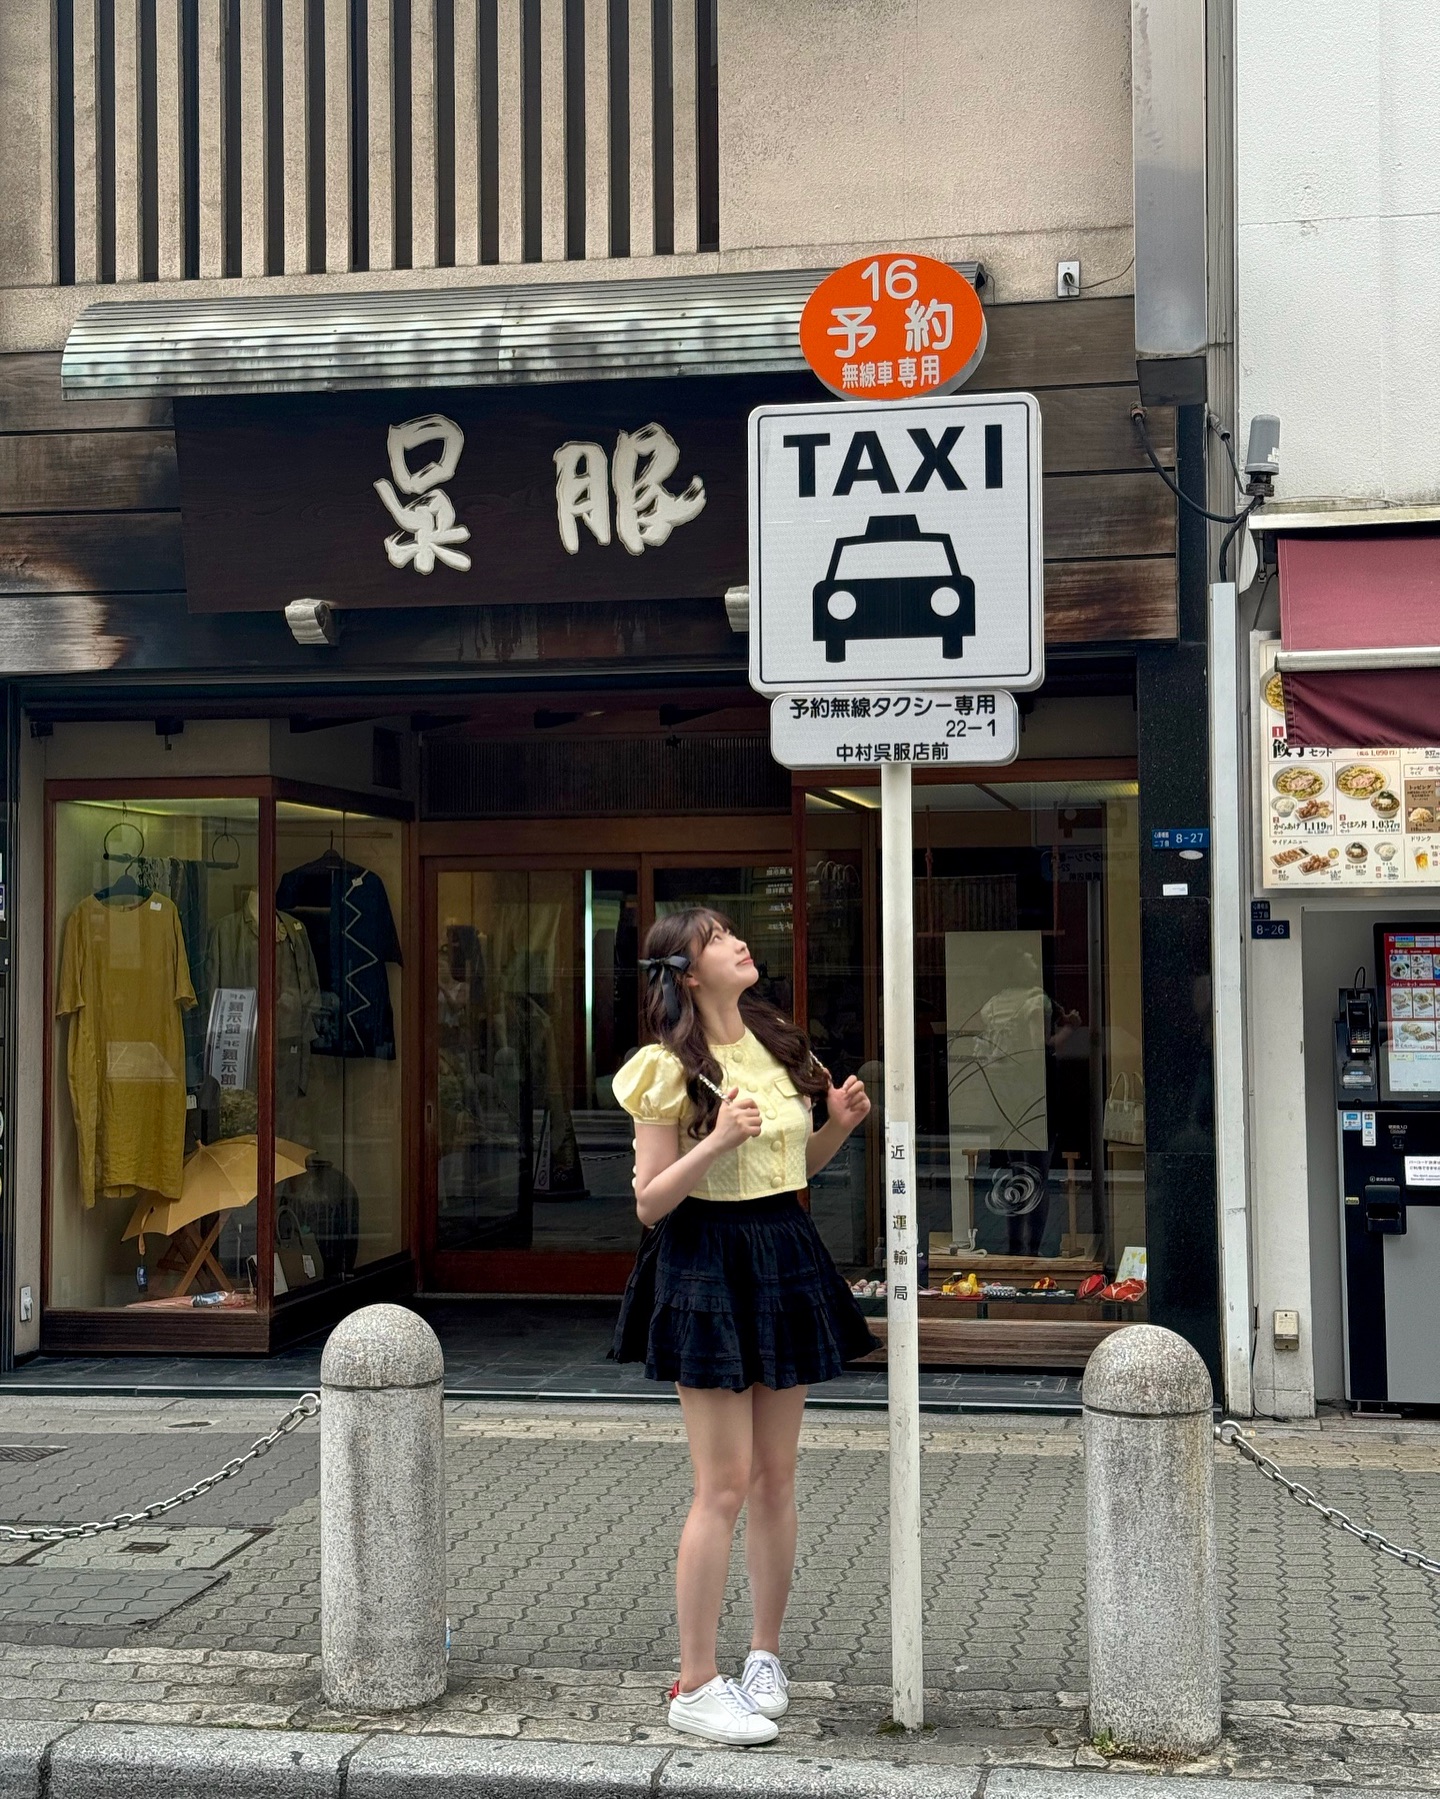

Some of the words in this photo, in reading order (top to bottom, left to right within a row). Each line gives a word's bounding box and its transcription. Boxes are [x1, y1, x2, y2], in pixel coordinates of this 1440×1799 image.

[862, 259, 918, 301] 16
[841, 354, 940, 389] 無線車専用
[783, 424, 1003, 498] TAXI
[789, 694, 996, 720] 予約無線タクシー専用
[836, 742, 949, 763] 中村呉服店前
[1175, 832, 1204, 844] 8-27
[1256, 924, 1285, 935] 8-26
[890, 1144, 908, 1301] 近畿運輸局
